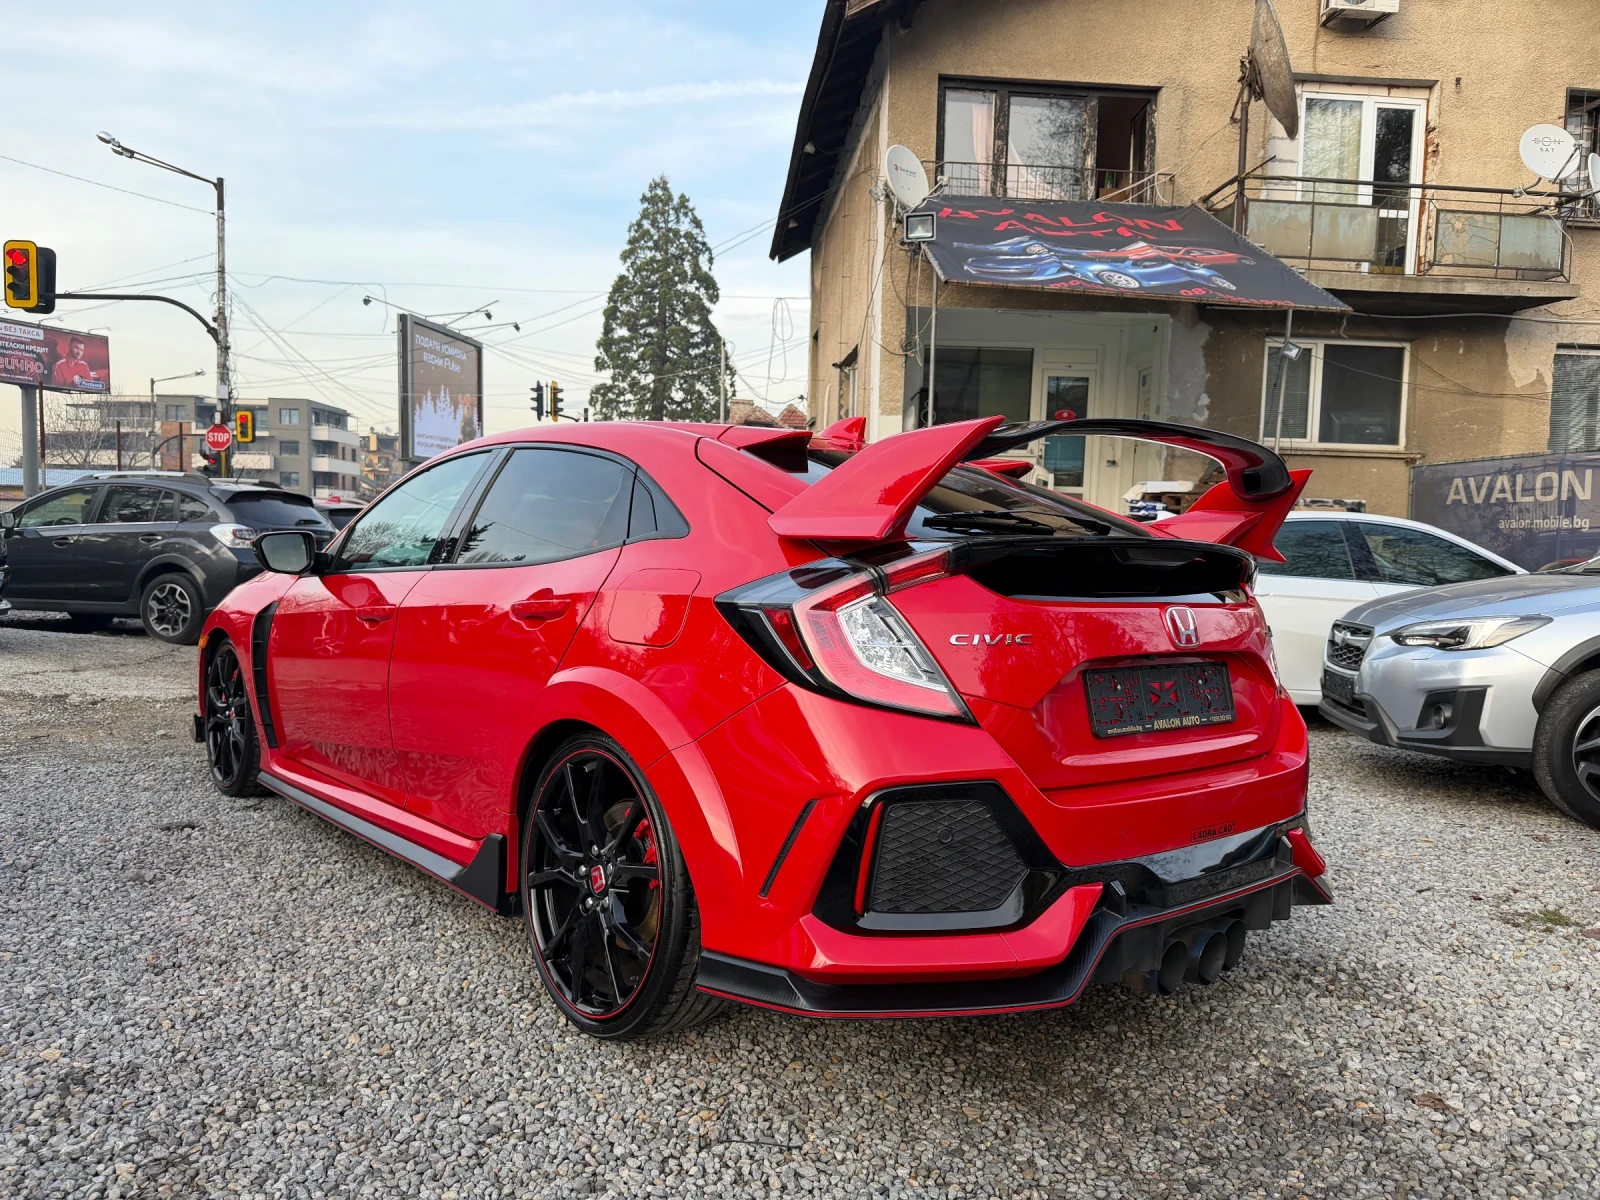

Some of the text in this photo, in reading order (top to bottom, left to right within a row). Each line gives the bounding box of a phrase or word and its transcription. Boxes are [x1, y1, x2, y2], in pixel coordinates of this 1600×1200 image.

[18, 328, 41, 337] ТАКСА
[26, 344, 49, 353] КРЕДИТ
[208, 432, 229, 442] STOP
[1446, 469, 1593, 505] AVALON
[1499, 515, 1590, 532] avalon.mobile.bg
[949, 633, 1033, 646] CIVIC
[1153, 717, 1181, 730] AVALON
[1182, 715, 1200, 727] AUTO
